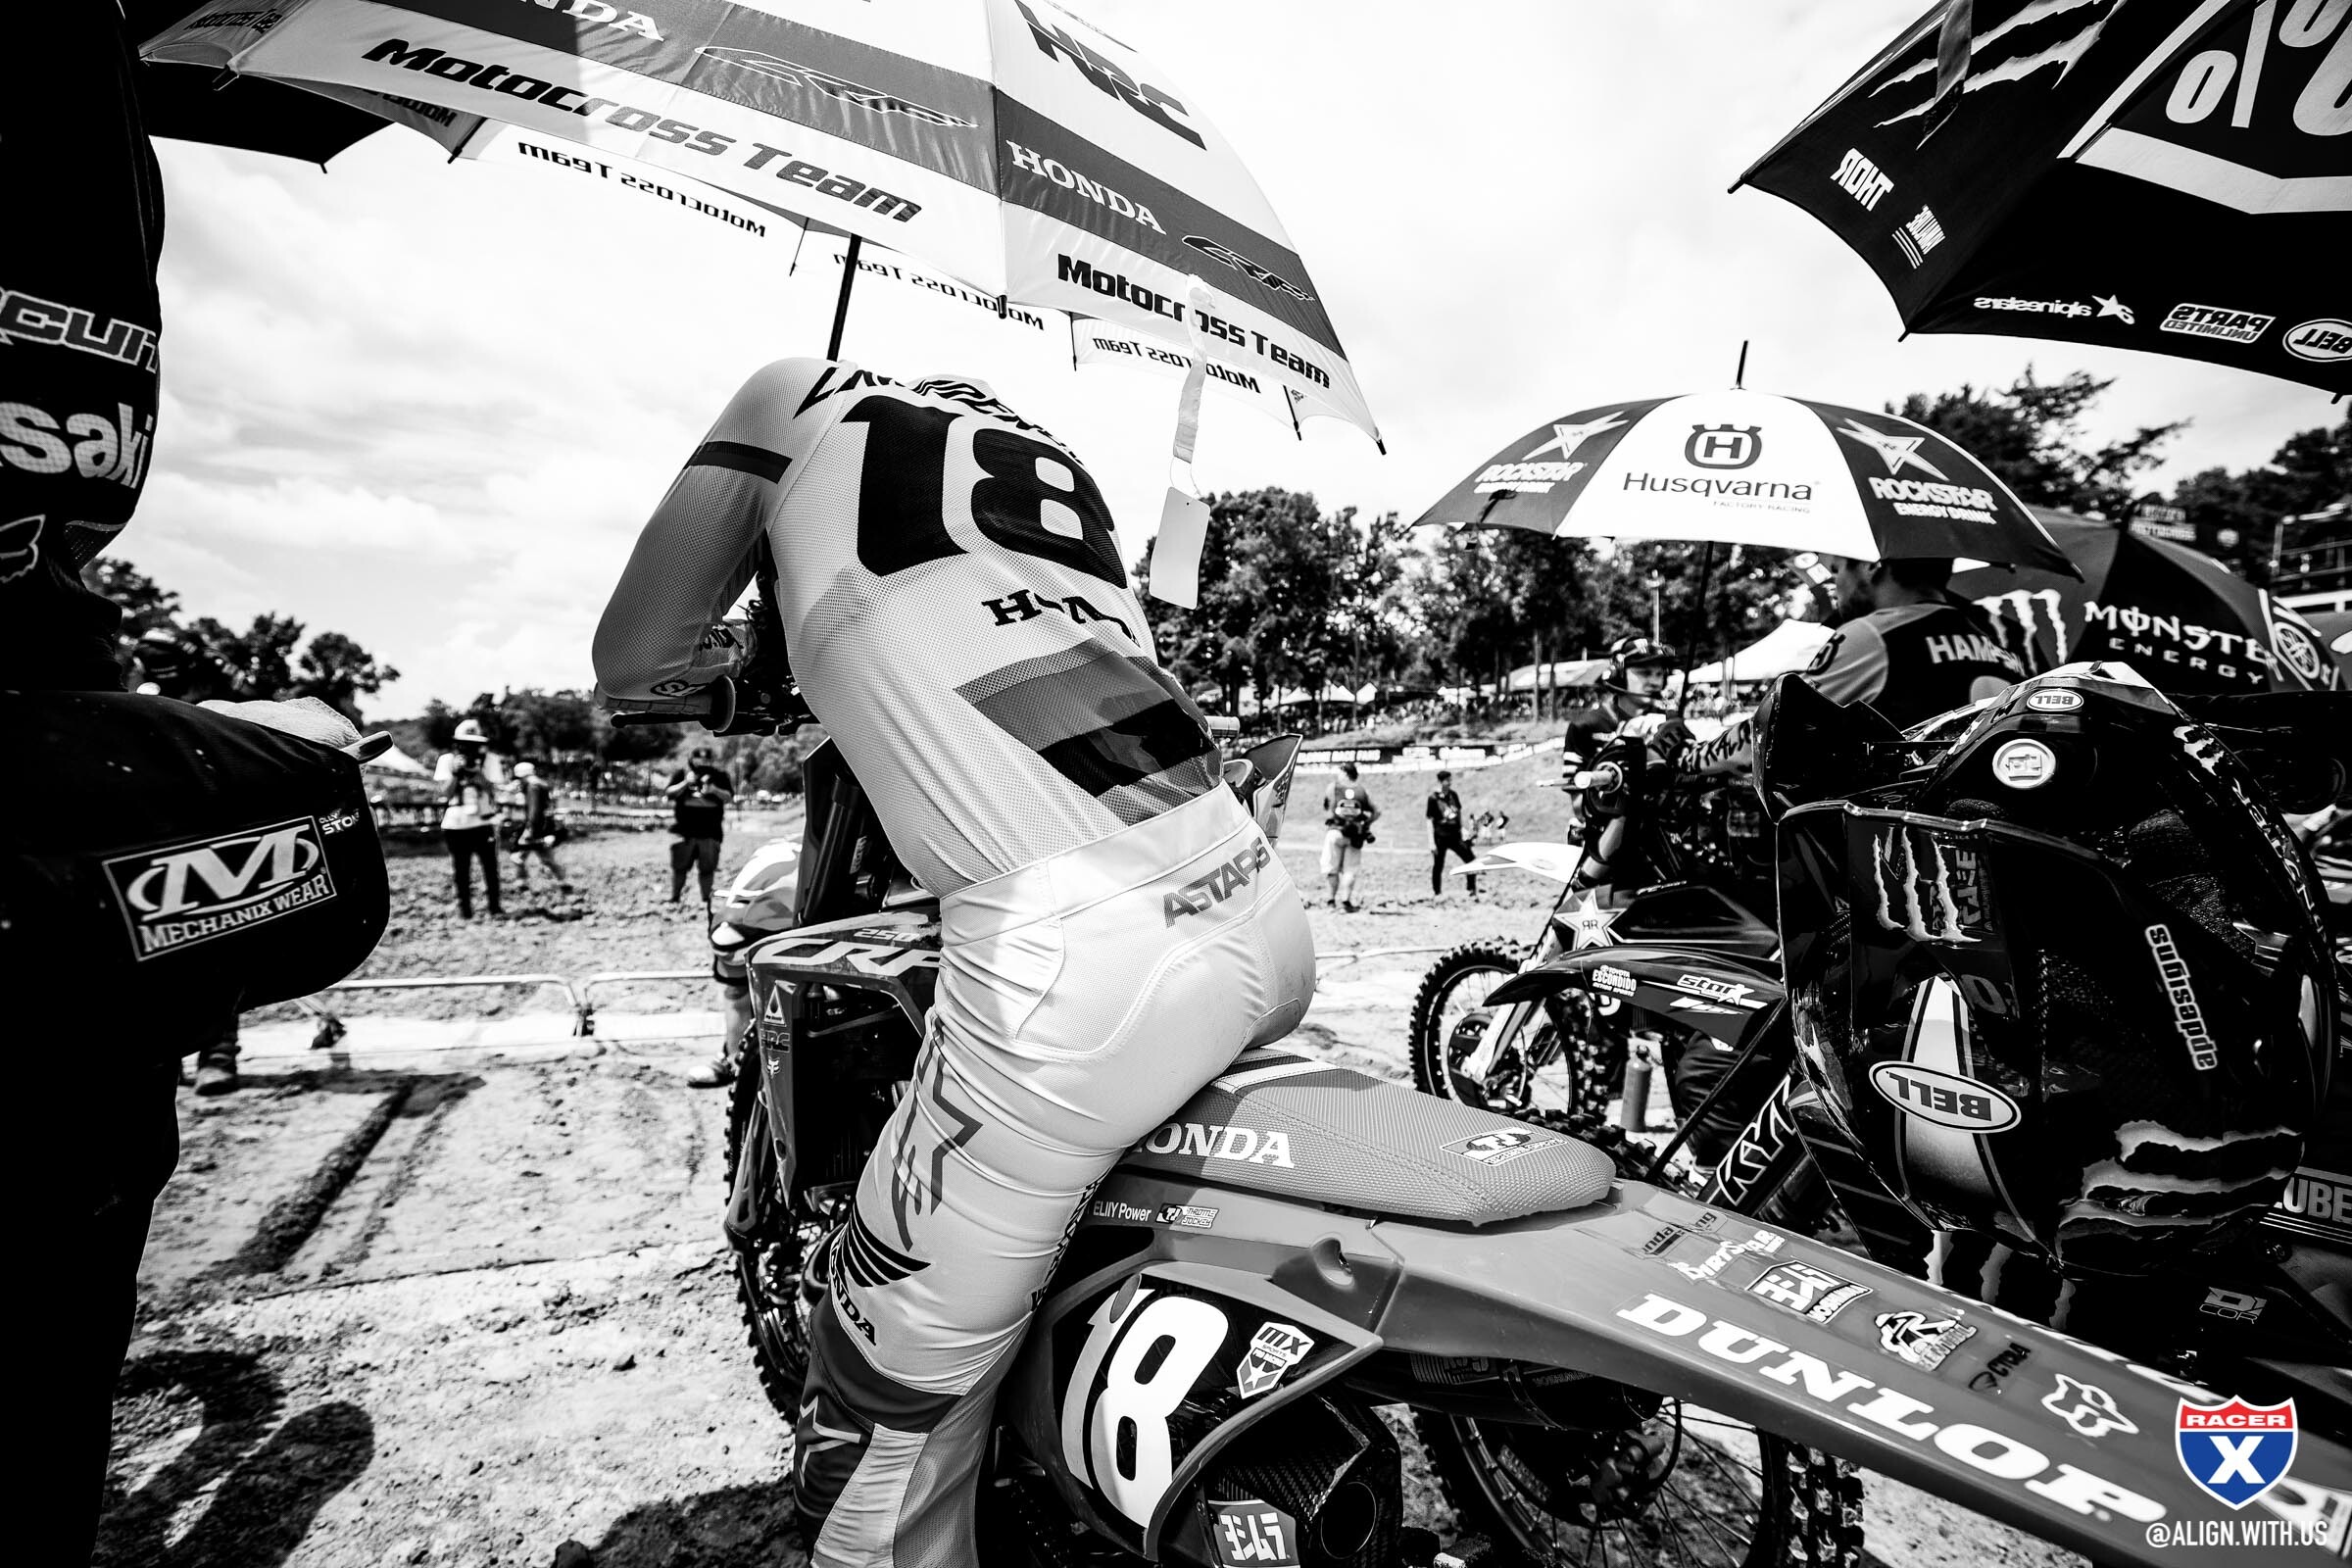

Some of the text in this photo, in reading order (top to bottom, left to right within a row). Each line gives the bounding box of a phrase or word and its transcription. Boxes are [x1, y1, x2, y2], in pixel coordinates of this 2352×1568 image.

[361, 38, 737, 157] Motocross
[742, 142, 922, 222] Team
[1005, 139, 1167, 235] HONDA
[1250, 329, 1331, 389] Team
[0, 402, 154, 489] saki
[839, 393, 1129, 590] 18
[1622, 472, 1813, 502] Husqvarna
[2109, 636, 2266, 685] ENERGY
[2035, 695, 2075, 706] BELL
[138, 873, 329, 952] MECHANIX WEAR
[1886, 1070, 1993, 1122] BELL
[1139, 1123, 1296, 1169] ONDA
[1118, 1202, 1152, 1222] Power
[2273, 1176, 2352, 1225] UBE
[1061, 1287, 1229, 1529] 18
[1616, 1293, 2168, 1525] DUNLOP
